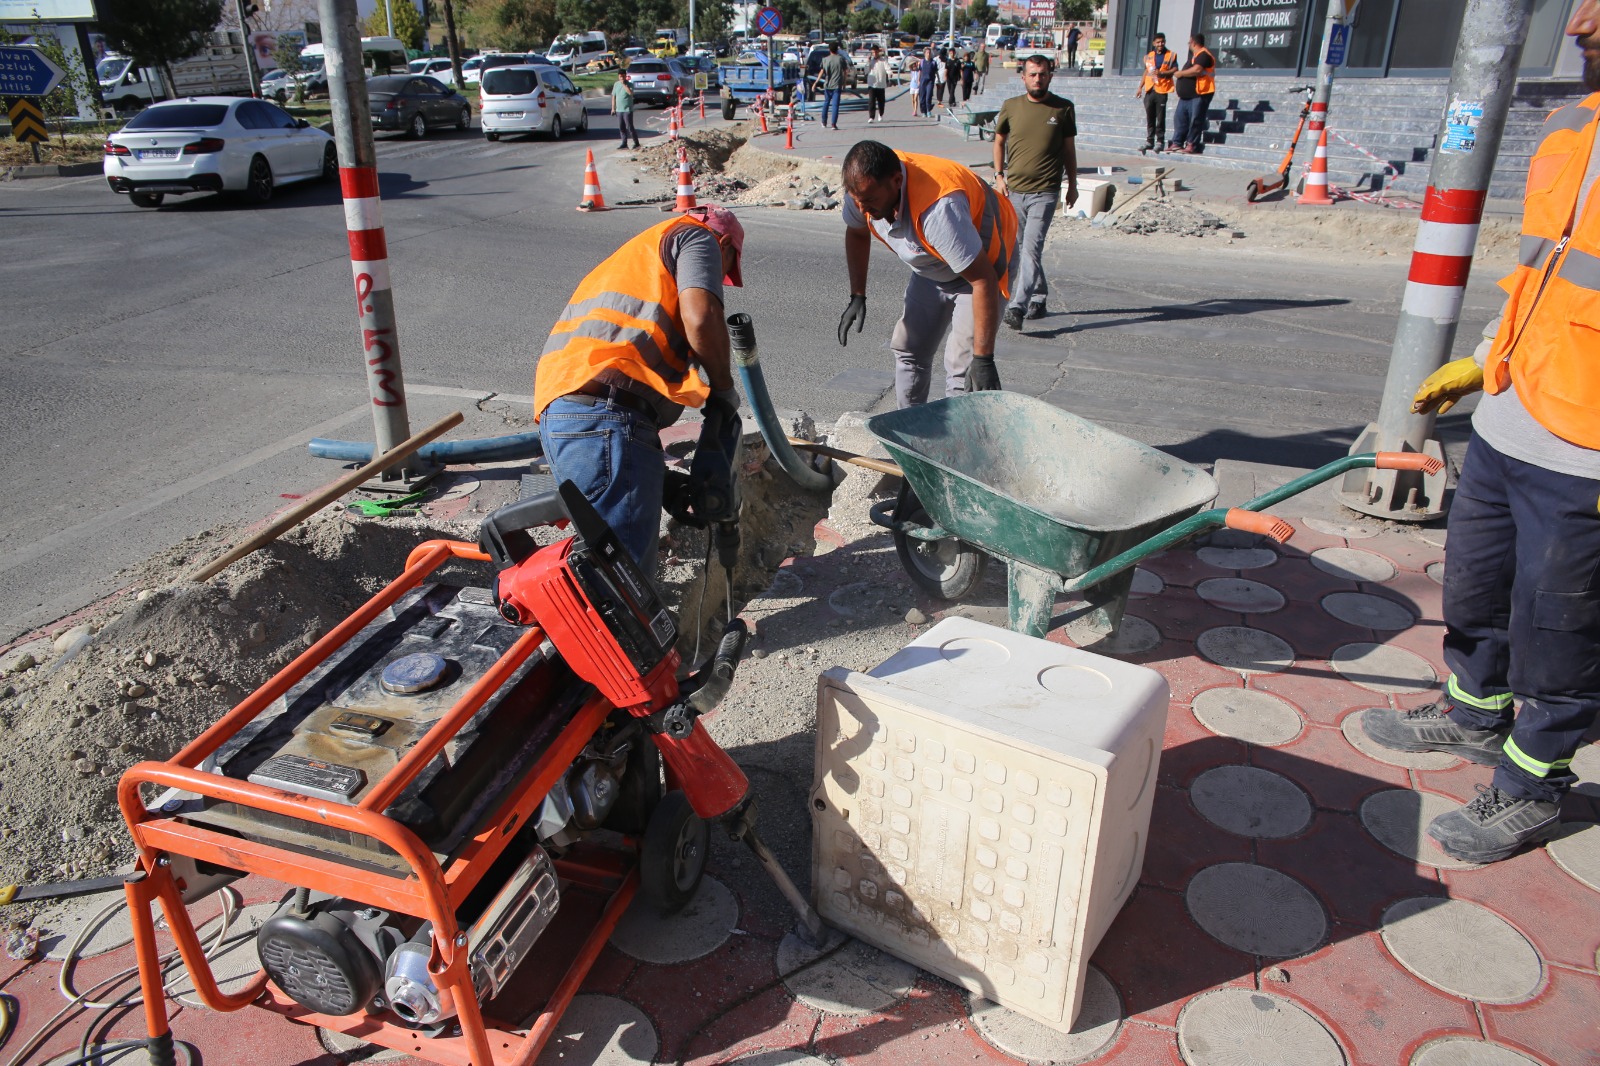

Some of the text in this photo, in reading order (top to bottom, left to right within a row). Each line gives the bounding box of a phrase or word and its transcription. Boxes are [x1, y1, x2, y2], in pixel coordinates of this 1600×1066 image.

[1213, 12, 1291, 29] 3 KAT ÖZEL OTOPARK
[1218, 33, 1285, 46] 1+1 2+1 3+1
[0, 51, 30, 60] lvan
[0, 63, 36, 71] ozluk
[0, 73, 33, 81] ason
[0, 82, 31, 91] itlis
